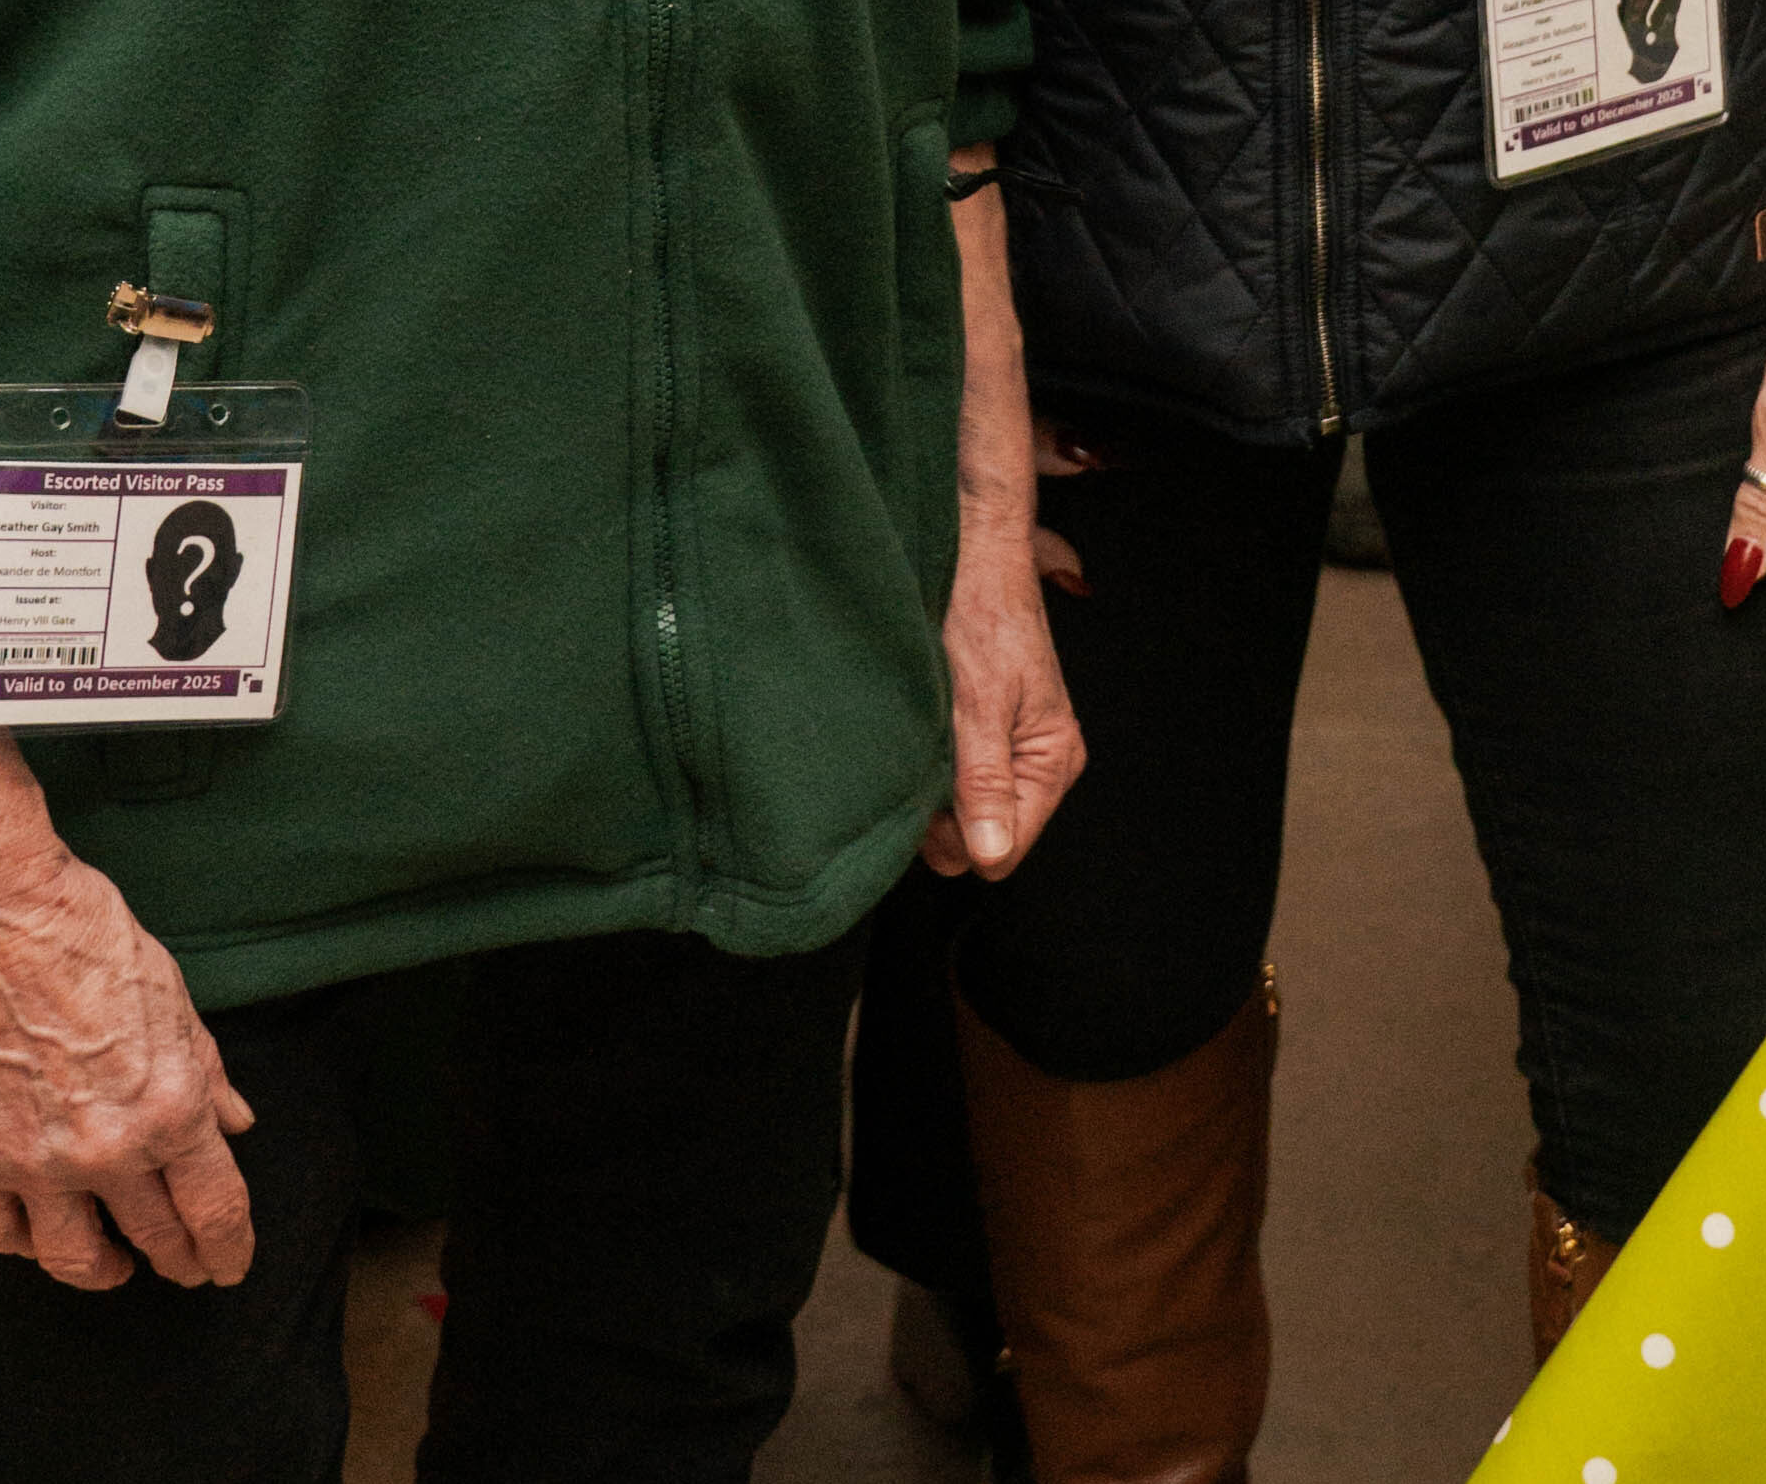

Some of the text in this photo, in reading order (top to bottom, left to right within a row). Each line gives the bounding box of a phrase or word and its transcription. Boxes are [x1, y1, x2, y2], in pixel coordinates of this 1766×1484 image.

[1532, 124, 1562, 142] Valid
[1564, 120, 1577, 132] to
[1597, 98, 1655, 123] December
[1656, 86, 1684, 106] 2025
[43, 472, 225, 492] Escorted Visitor Pass
[30, 500, 67, 511] Visitor:
[41, 522, 65, 535] Gay
[67, 522, 100, 533] Smith
[30, 548, 57, 558] Host:
[36, 566, 50, 577] de
[53, 566, 102, 577] Montfort
[15, 595, 63, 605] Issued at:
[0, 616, 31, 628] Henry
[51, 616, 76, 625] Gate
[3, 674, 222, 693] Valid to 04 December 2025
